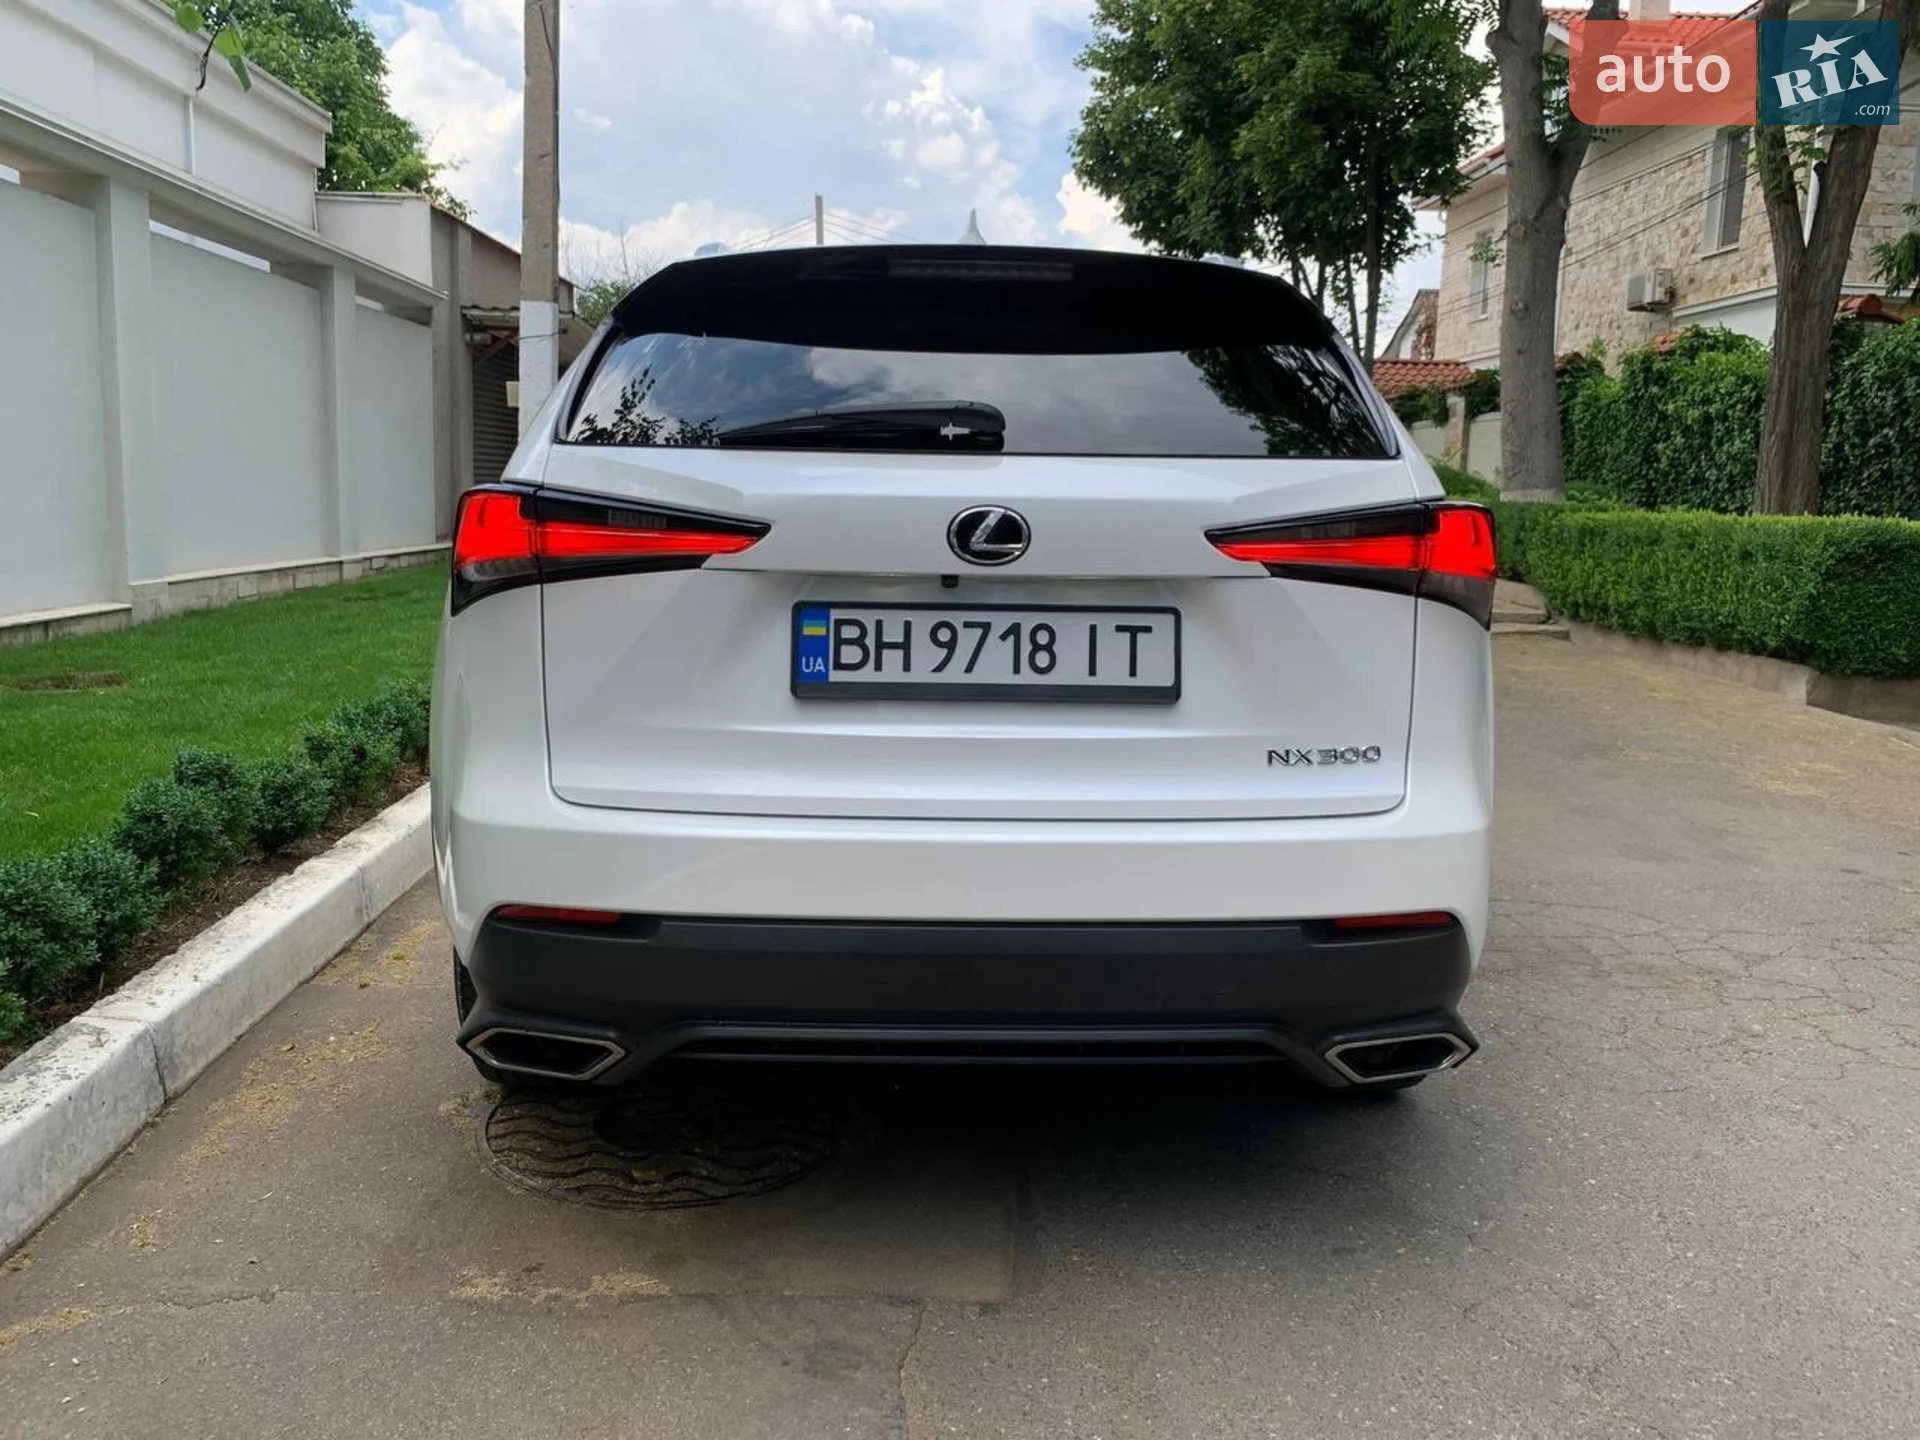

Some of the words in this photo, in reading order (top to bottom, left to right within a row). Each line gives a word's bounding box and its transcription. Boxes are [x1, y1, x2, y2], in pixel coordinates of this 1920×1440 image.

[802, 656, 826, 674] UA
[832, 618, 912, 673] BH
[929, 620, 1057, 676] 9718
[1088, 624, 1154, 678] IT
